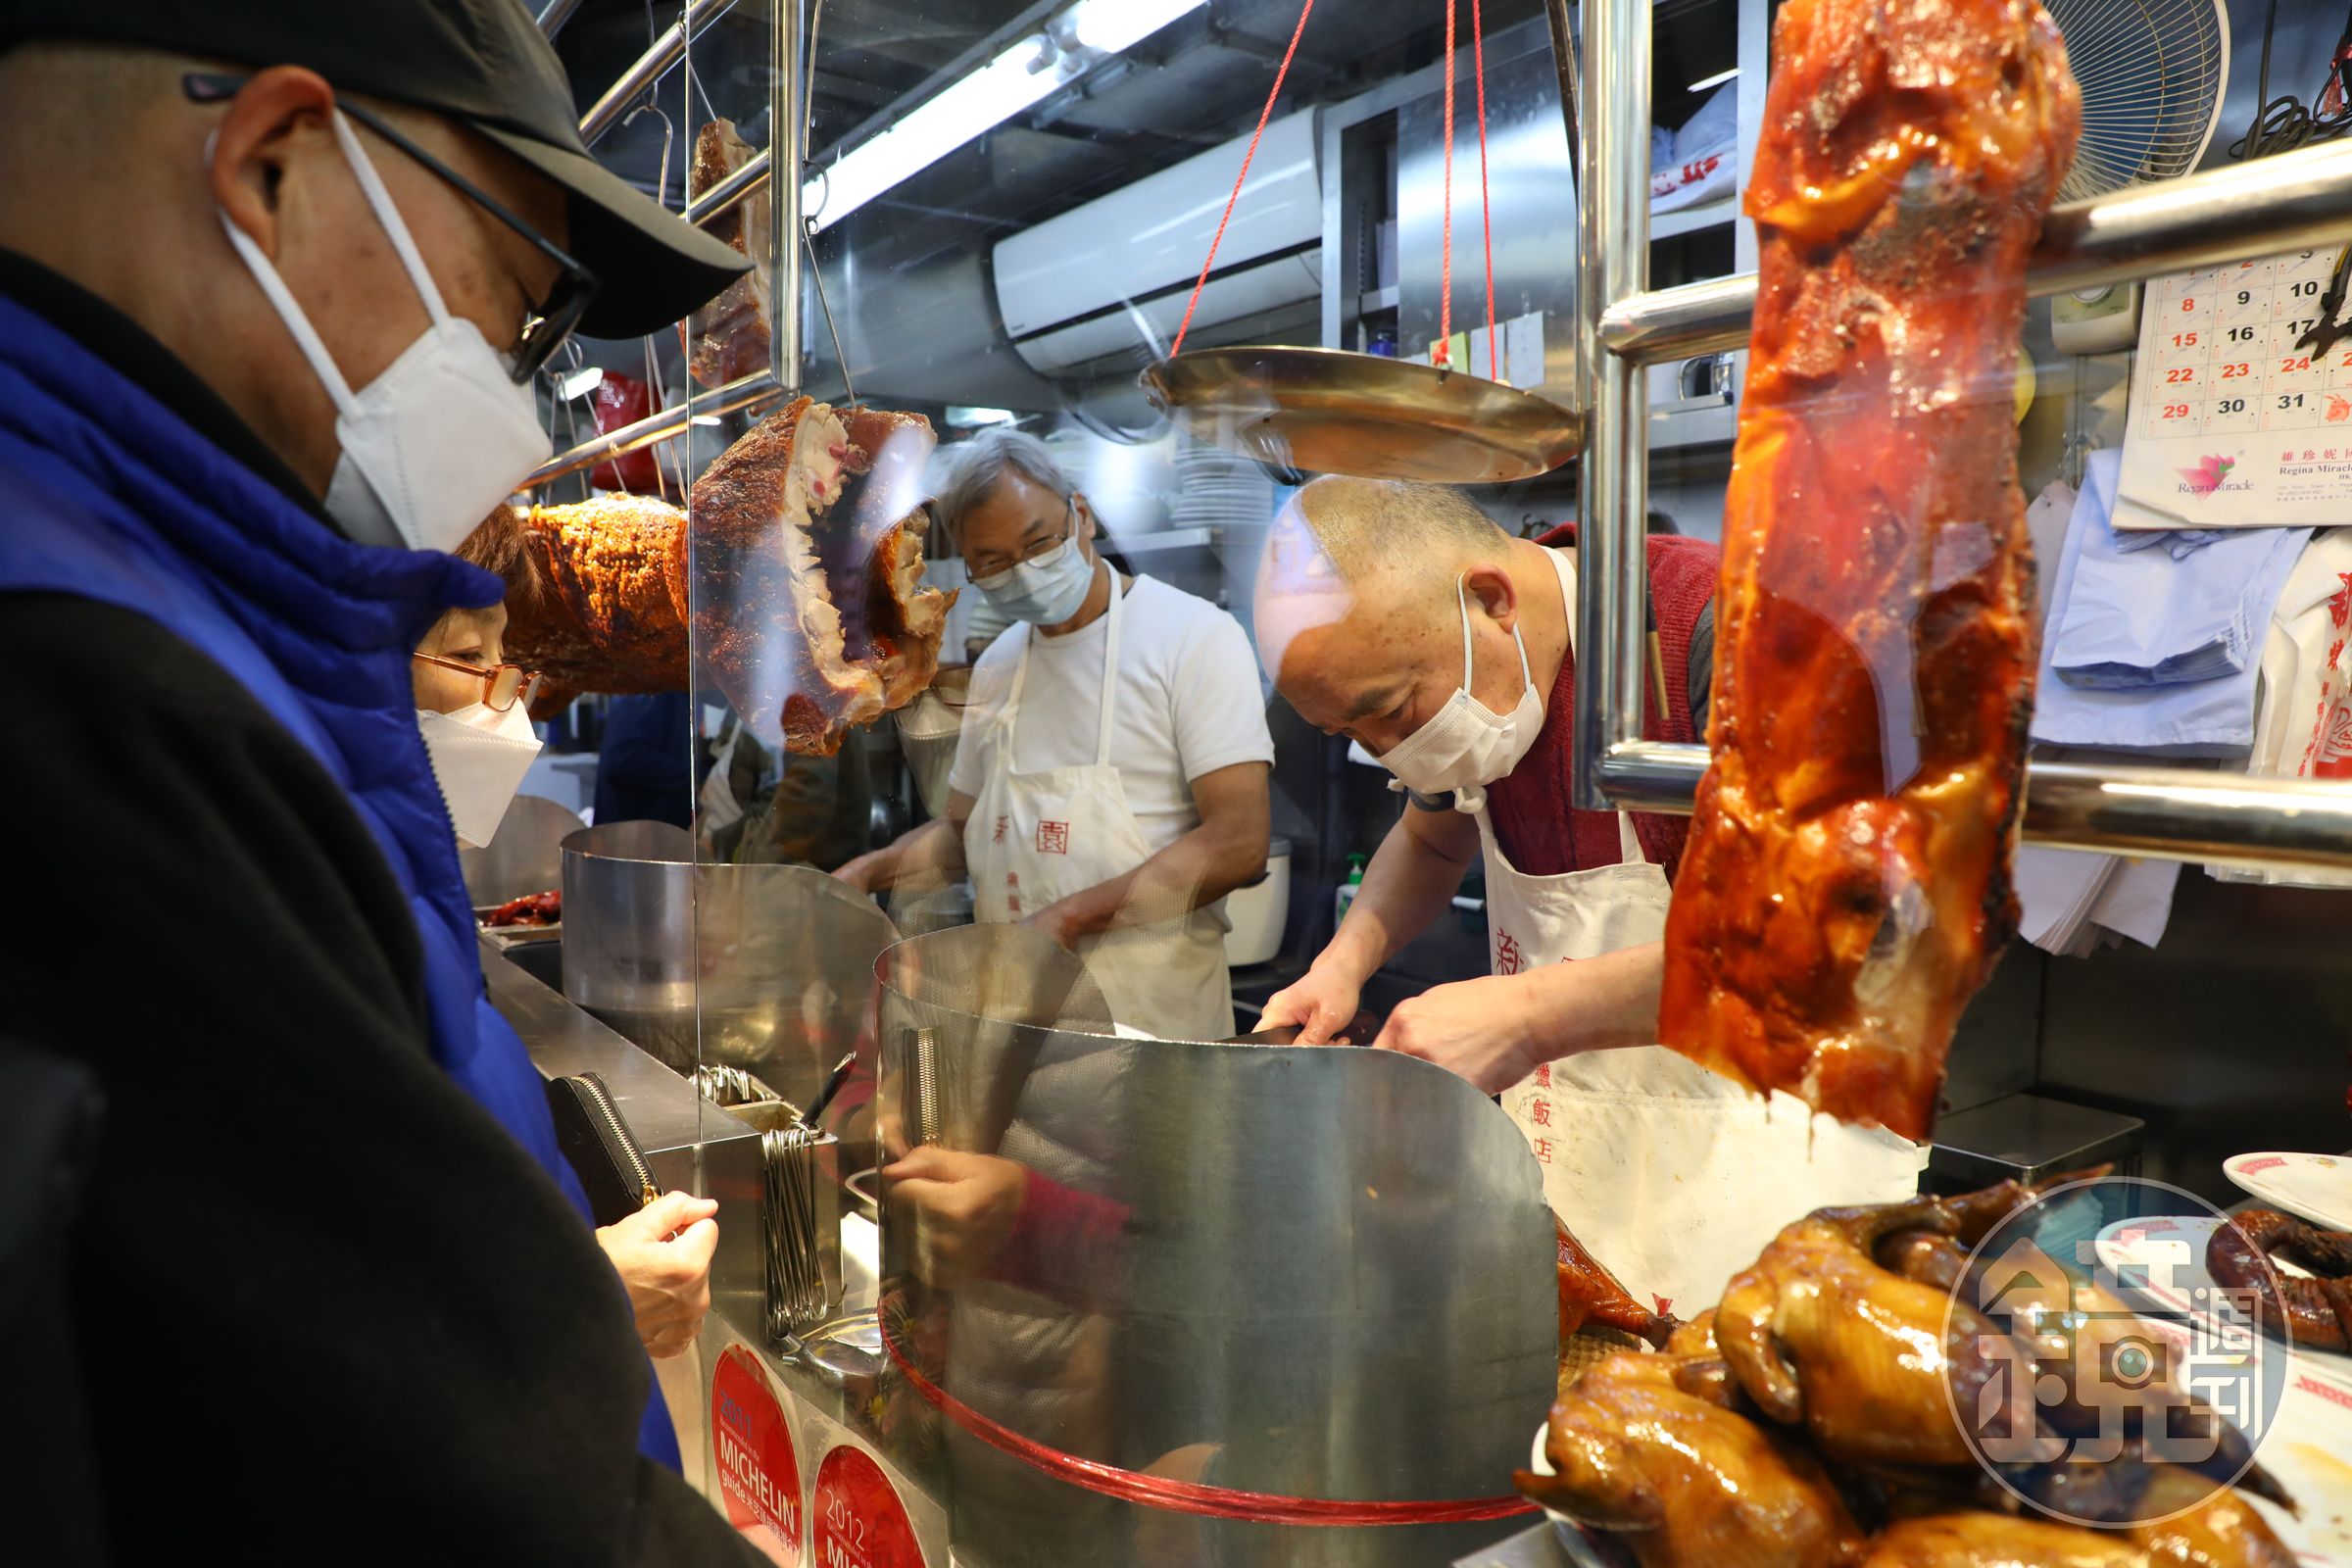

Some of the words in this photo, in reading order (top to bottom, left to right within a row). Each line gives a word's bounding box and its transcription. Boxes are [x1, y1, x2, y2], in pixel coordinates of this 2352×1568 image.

[2181, 298, 2194, 313] 8
[2237, 291, 2251, 305] 9
[2290, 281, 2318, 297] 10
[2172, 332, 2197, 347] 15
[2228, 326, 2254, 341] 16
[2287, 319, 2315, 334] 17
[2167, 368, 2193, 383] 22
[2222, 363, 2249, 378] 23
[2281, 357, 2311, 372] 24
[2162, 404, 2189, 418] 29
[2218, 399, 2245, 414] 30
[2278, 394, 2304, 410] 31
[2279, 466, 2314, 476] Regina
[719, 1390, 752, 1441] 2011
[720, 1430, 796, 1536] MICHELIN
[721, 1468, 746, 1504] guide
[826, 1490, 864, 1552] 2012
